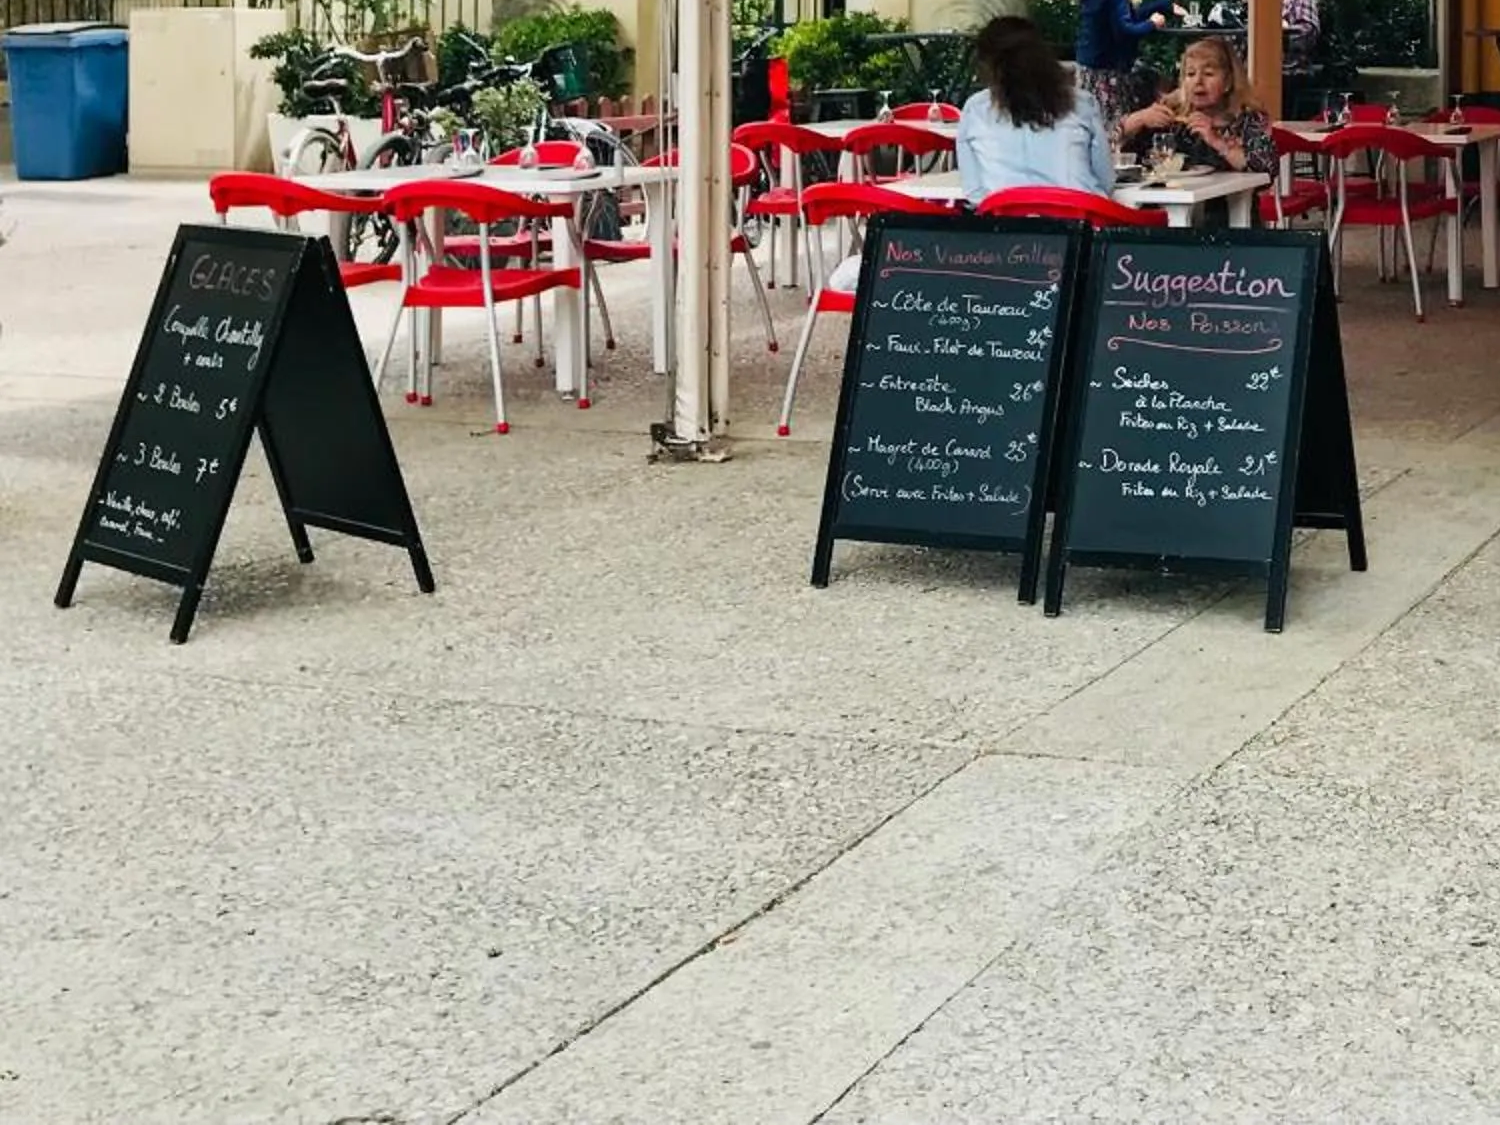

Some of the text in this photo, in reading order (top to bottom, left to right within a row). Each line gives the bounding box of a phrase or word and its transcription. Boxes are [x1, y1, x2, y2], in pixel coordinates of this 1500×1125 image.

[886, 241, 923, 263] Nos
[189, 254, 276, 301] GLACES
[1112, 254, 1296, 308] Suggestion
[891, 290, 933, 312] Côte
[937, 295, 959, 313] de
[961, 294, 1032, 318] Taureau
[1128, 311, 1171, 331] Nos
[967, 343, 984, 357] de
[1112, 366, 1169, 390] Seiches
[915, 396, 1005, 424] Black Angus
[1135, 394, 1148, 409] à
[1151, 395, 1166, 410] la
[134, 442, 146, 465] 3
[867, 435, 918, 465] Magret
[921, 442, 940, 456] de
[1100, 448, 1163, 473] Dorade
[1169, 451, 1224, 480] Royale
